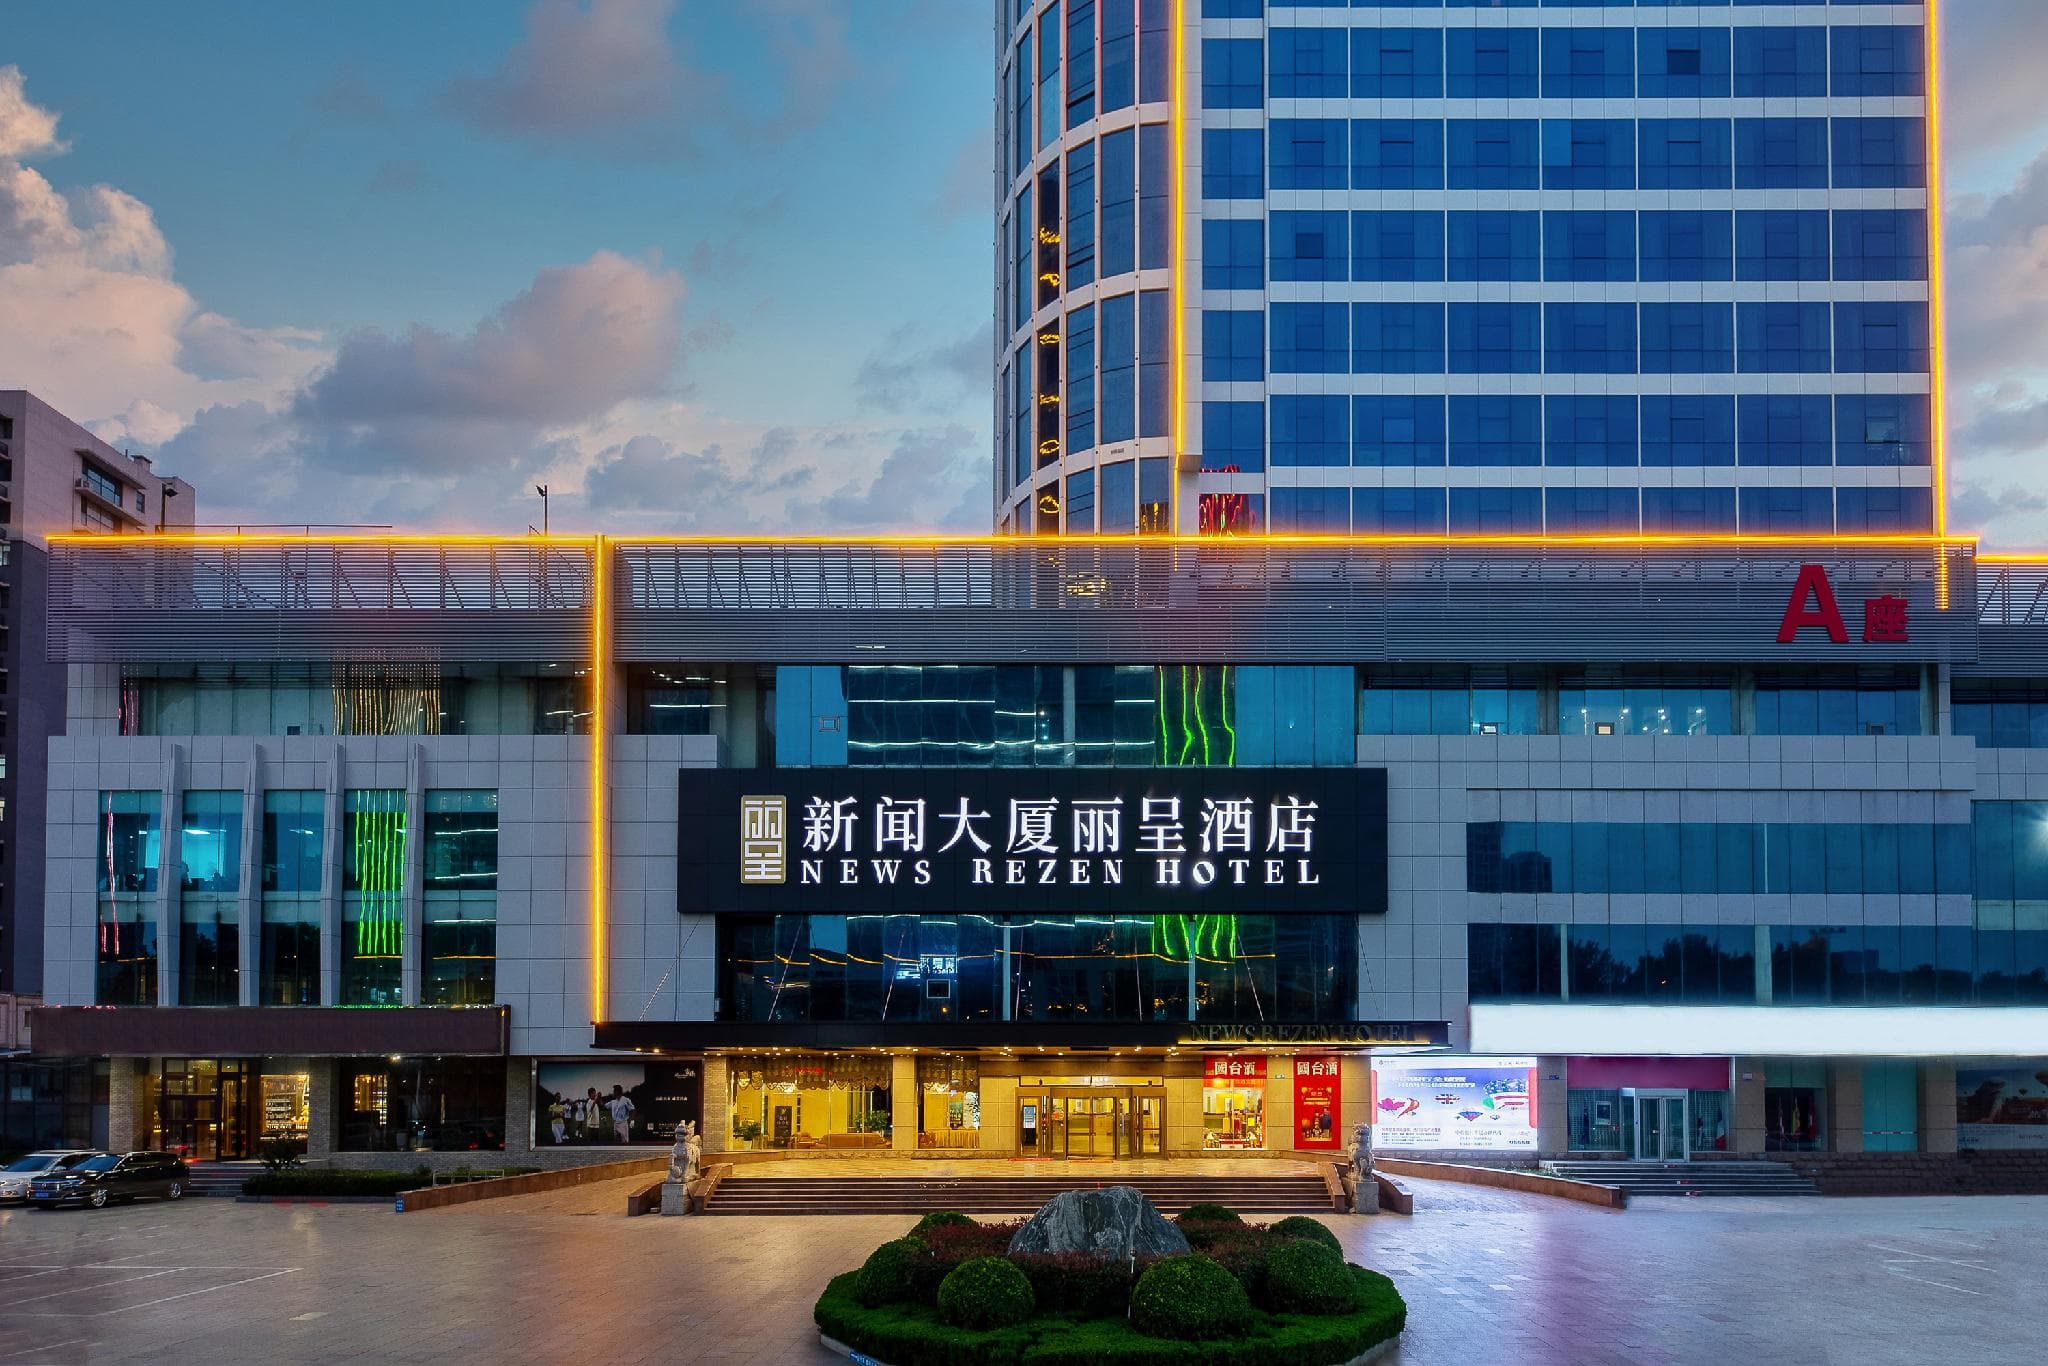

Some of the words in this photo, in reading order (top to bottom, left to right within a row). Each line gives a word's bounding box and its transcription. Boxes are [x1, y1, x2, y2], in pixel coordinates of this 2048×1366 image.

[801, 795, 1320, 854] 新闻大厦丽呈酒店
[800, 858, 932, 886] NEWS
[971, 858, 1124, 885] REZEN
[1156, 858, 1319, 886] HOTEL
[1190, 1024, 1256, 1041] NEWS
